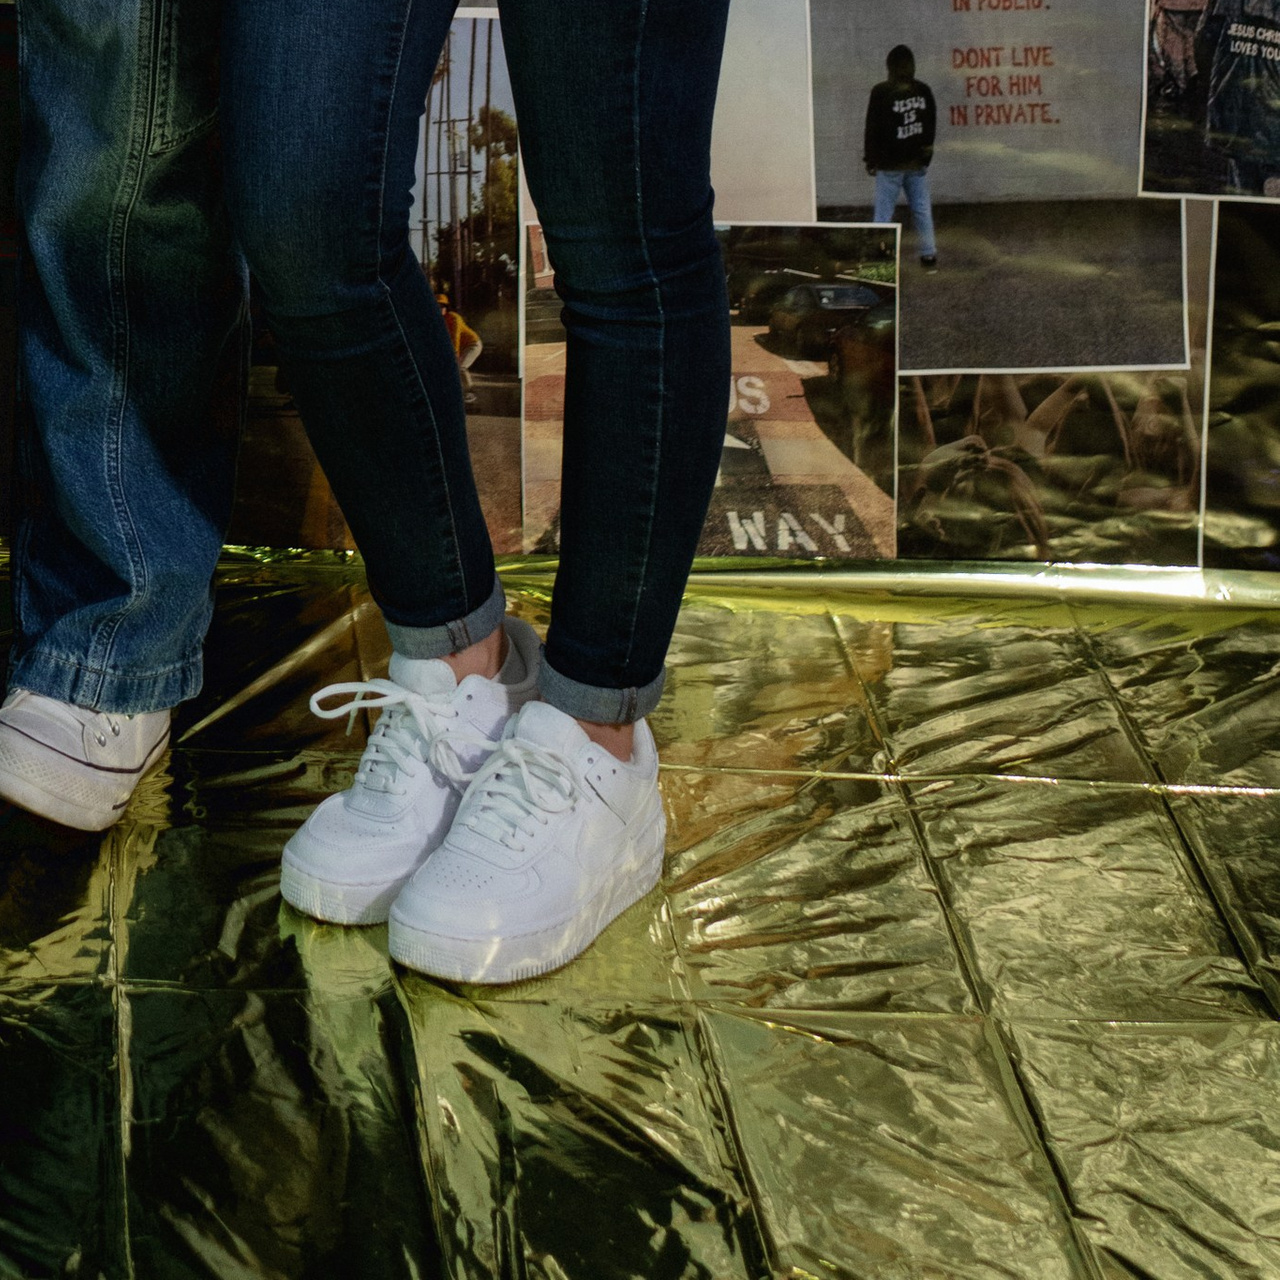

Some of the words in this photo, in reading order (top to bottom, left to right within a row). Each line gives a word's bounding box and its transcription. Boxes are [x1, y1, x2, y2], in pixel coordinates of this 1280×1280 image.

[952, 47, 1004, 69] DONT
[1012, 46, 1054, 68] LIVE
[1231, 40, 1259, 56] LOVES
[965, 76, 1003, 97] FOR
[1009, 74, 1042, 96] HIM
[950, 105, 968, 127] IN
[974, 103, 1061, 126] PRIVATE.
[726, 510, 852, 553] WAY
